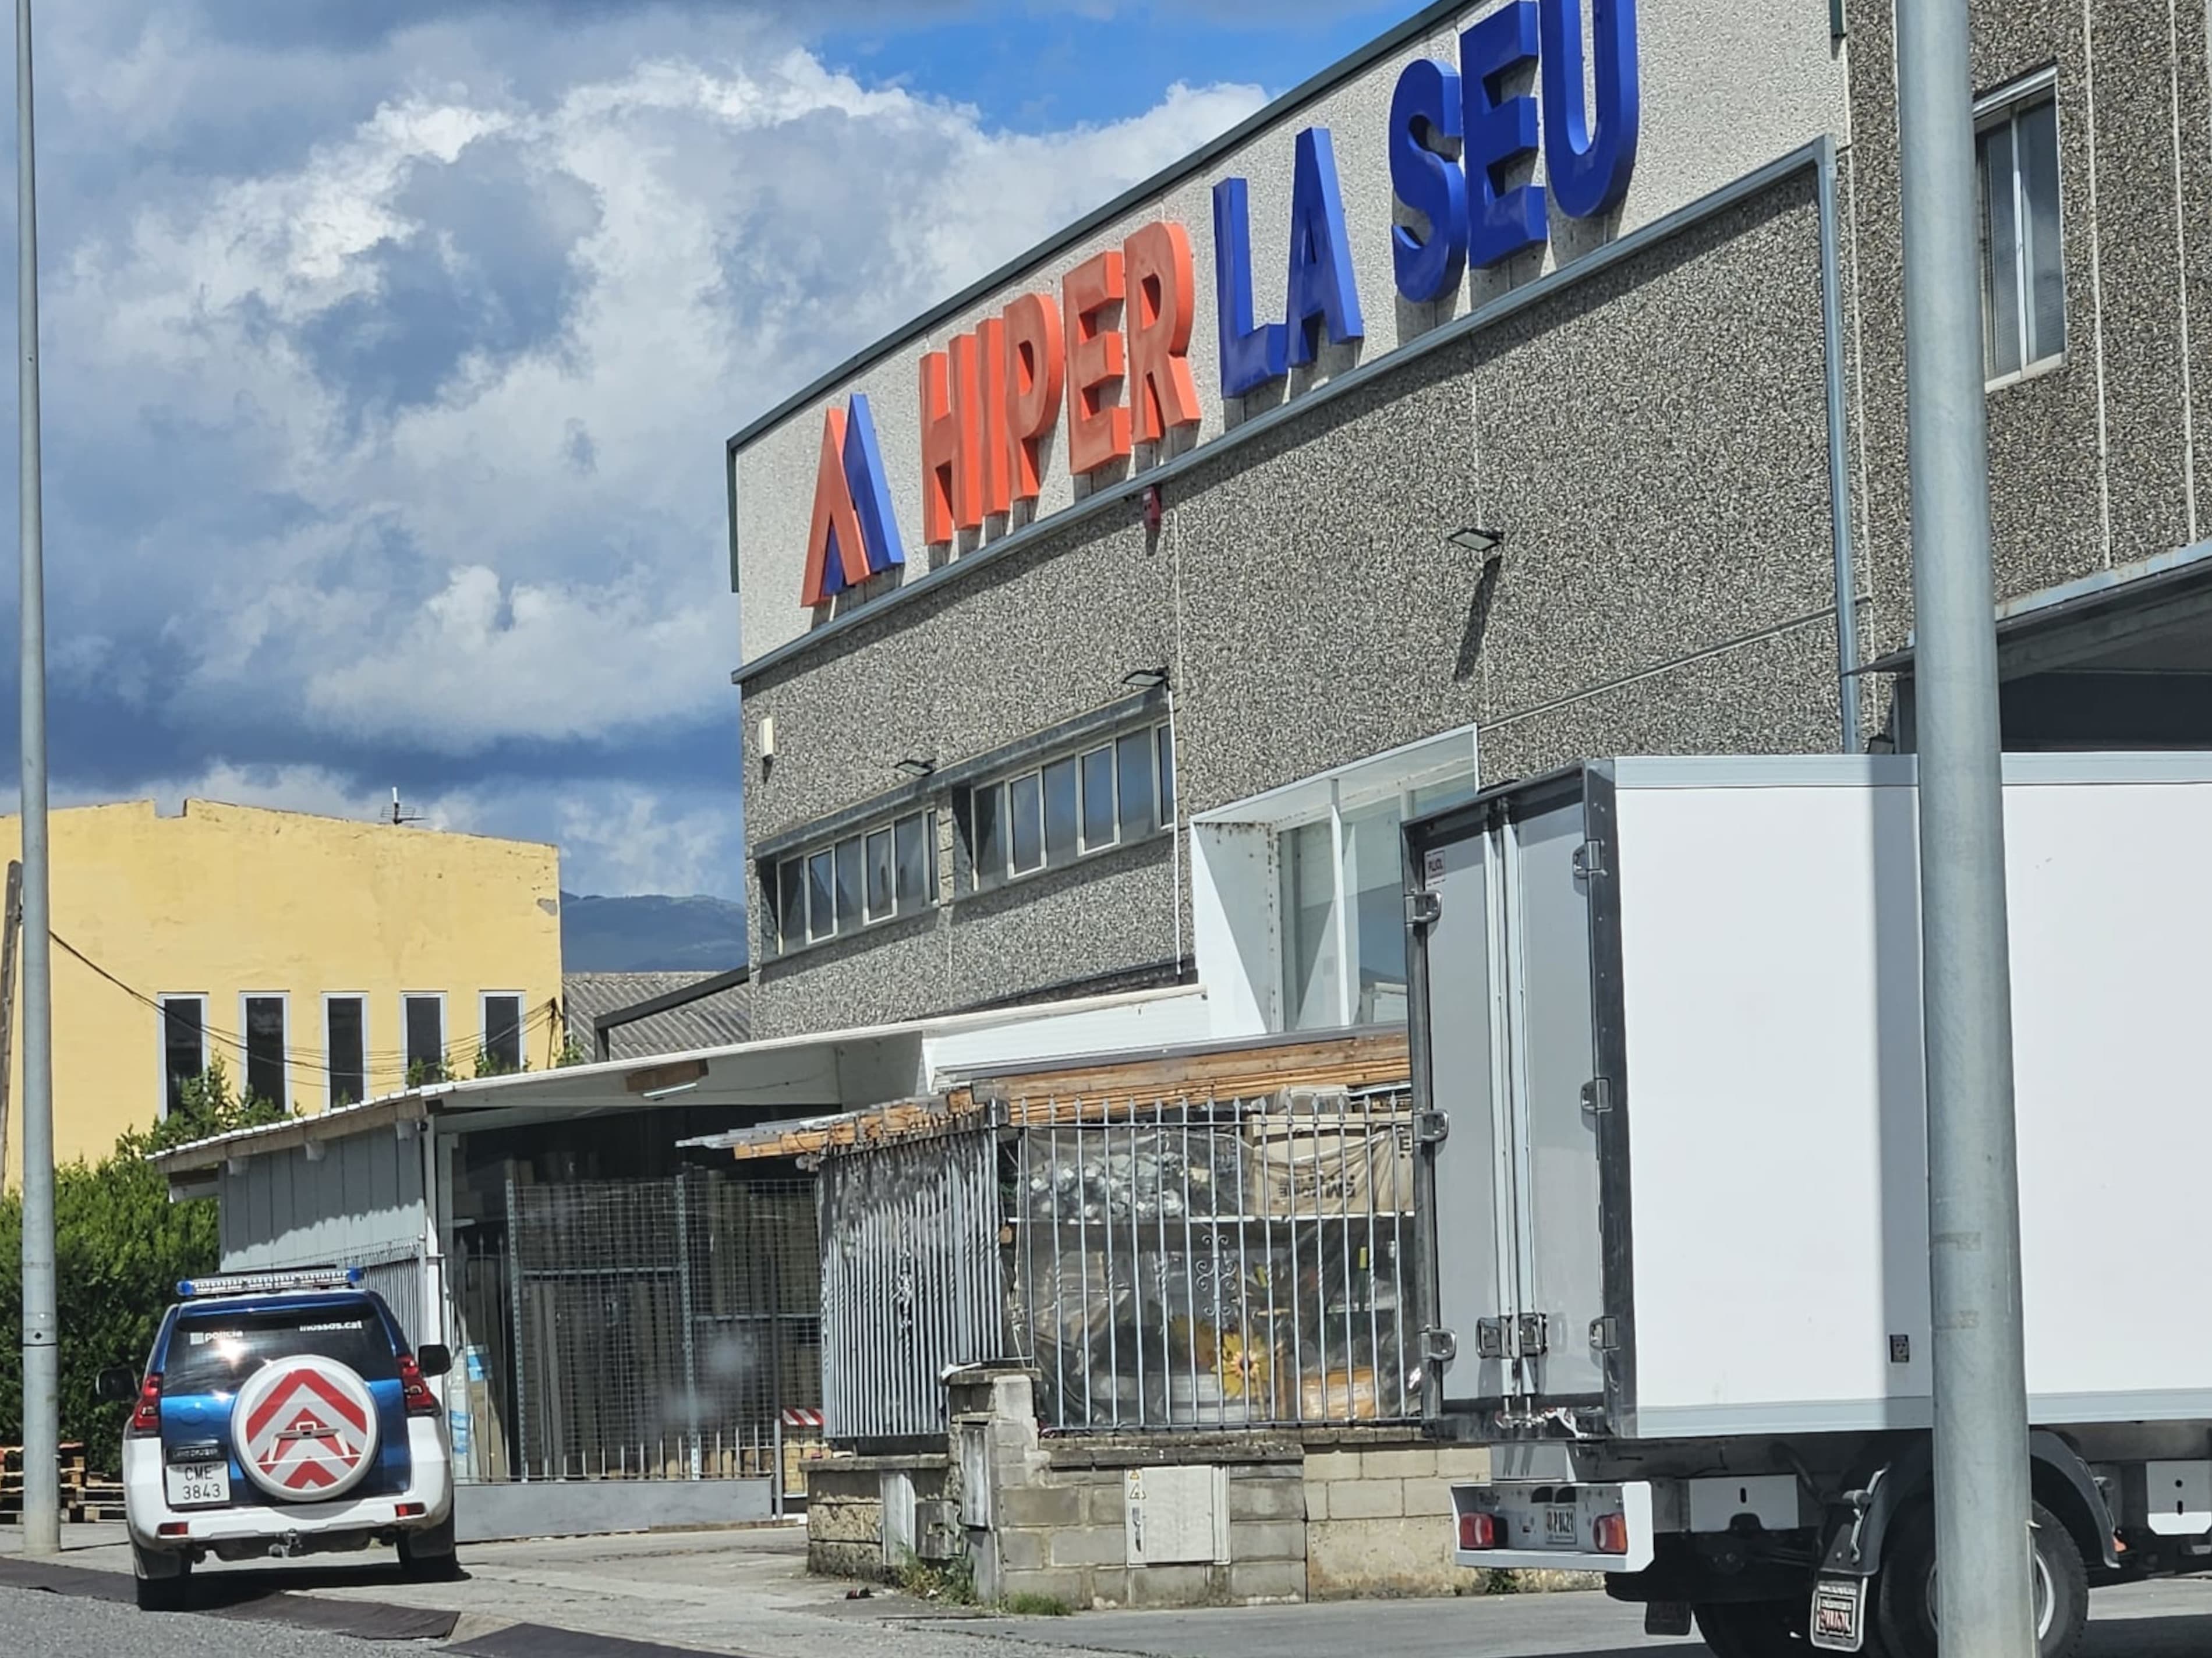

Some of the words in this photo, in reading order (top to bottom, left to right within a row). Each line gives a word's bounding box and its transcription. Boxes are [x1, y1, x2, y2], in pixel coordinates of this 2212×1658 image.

[919, 221, 1201, 545] HIPER
[1213, 128, 1364, 399] LA
[1389, 0, 1638, 303] SEU
[185, 1465, 213, 1480] CME
[183, 1483, 221, 1500] 3843
